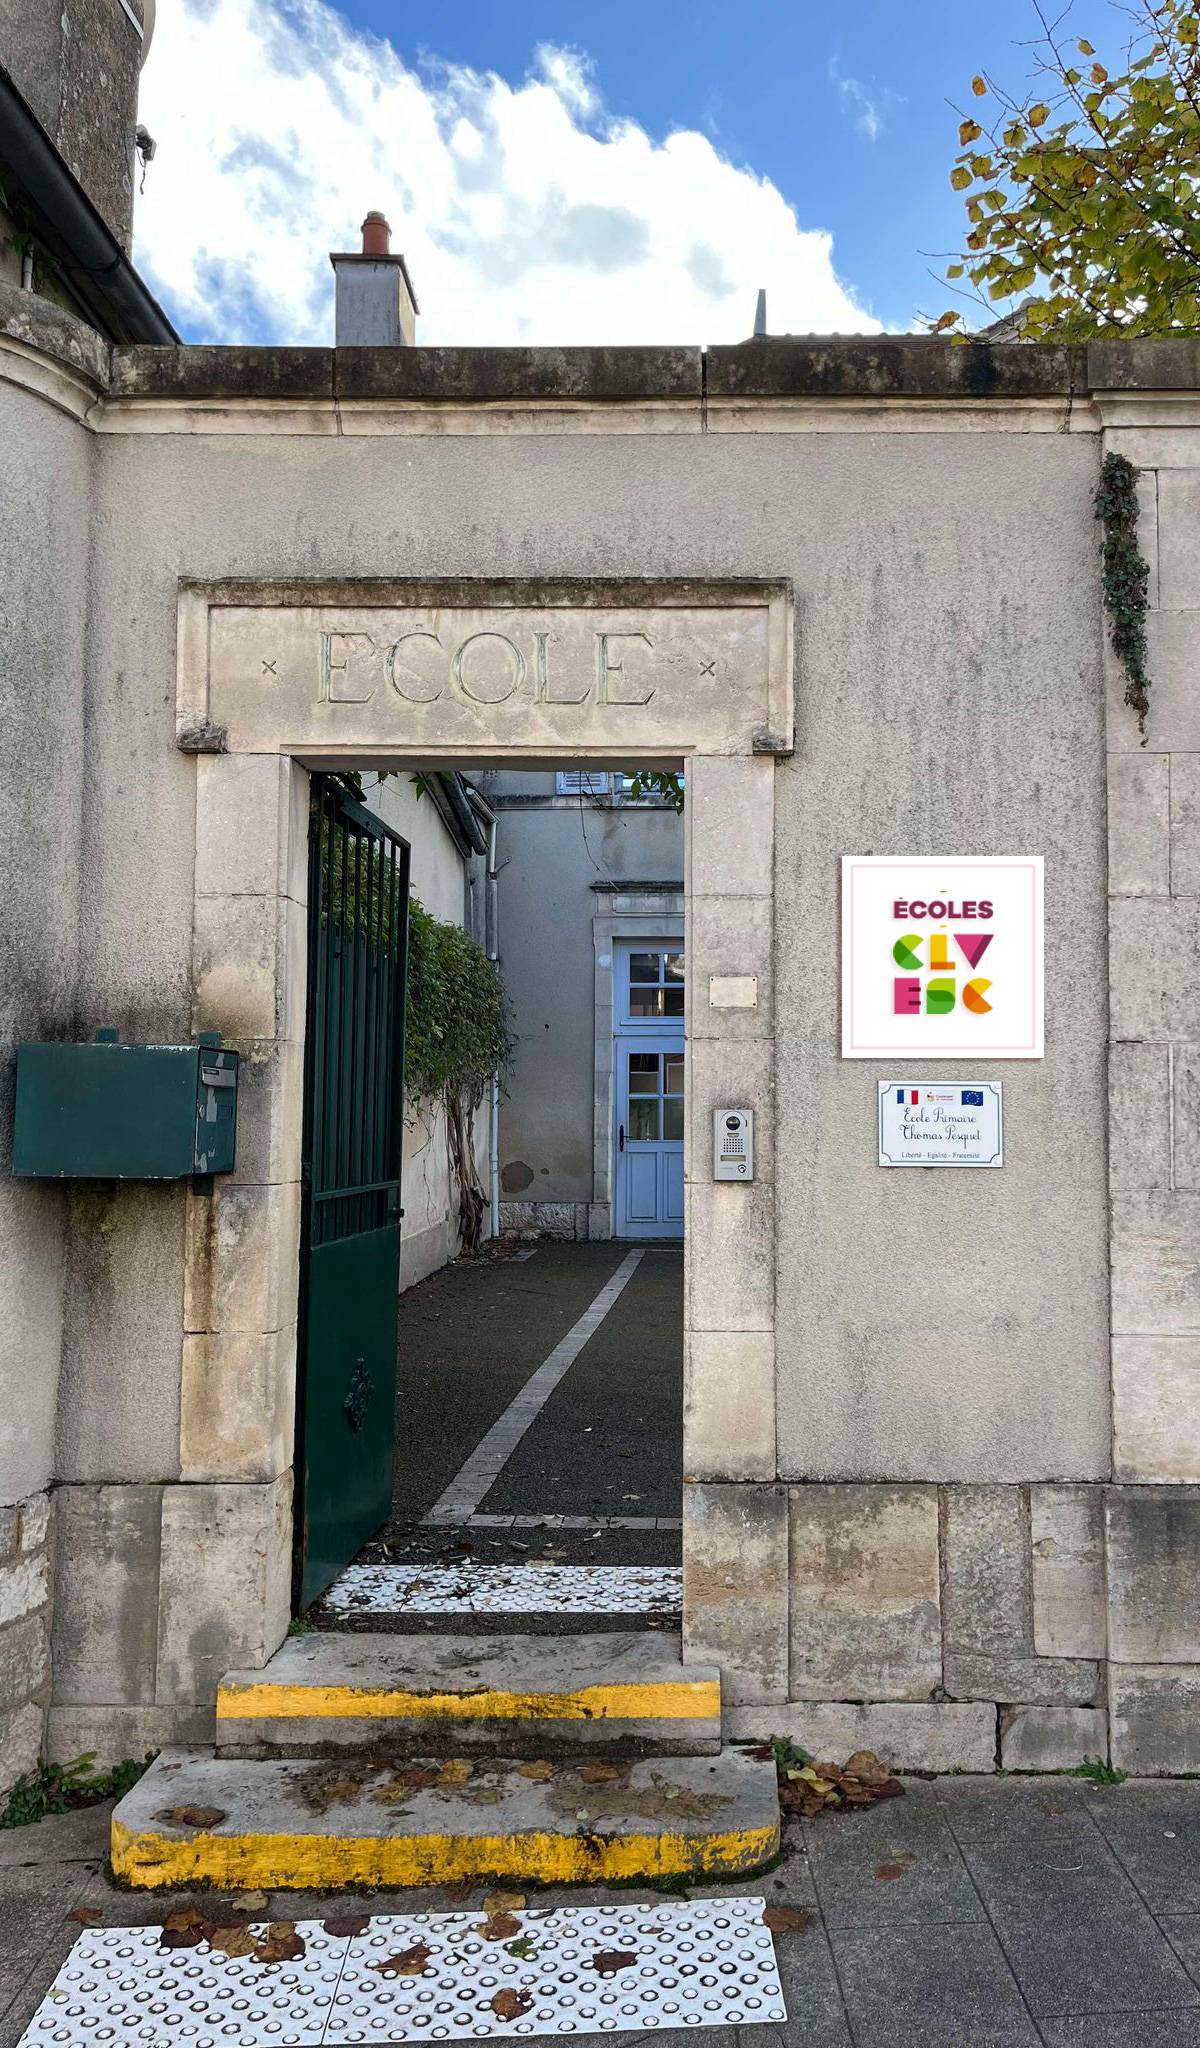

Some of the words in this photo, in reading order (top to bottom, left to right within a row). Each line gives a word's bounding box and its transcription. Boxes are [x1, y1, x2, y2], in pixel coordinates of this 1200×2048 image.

[317, 631, 657, 706] ECOLE
[903, 1107, 930, 1123] Ecole
[933, 1106, 977, 1123] Primaire
[899, 1123, 943, 1140] Thomas
[945, 1124, 981, 1150] Pesquet
